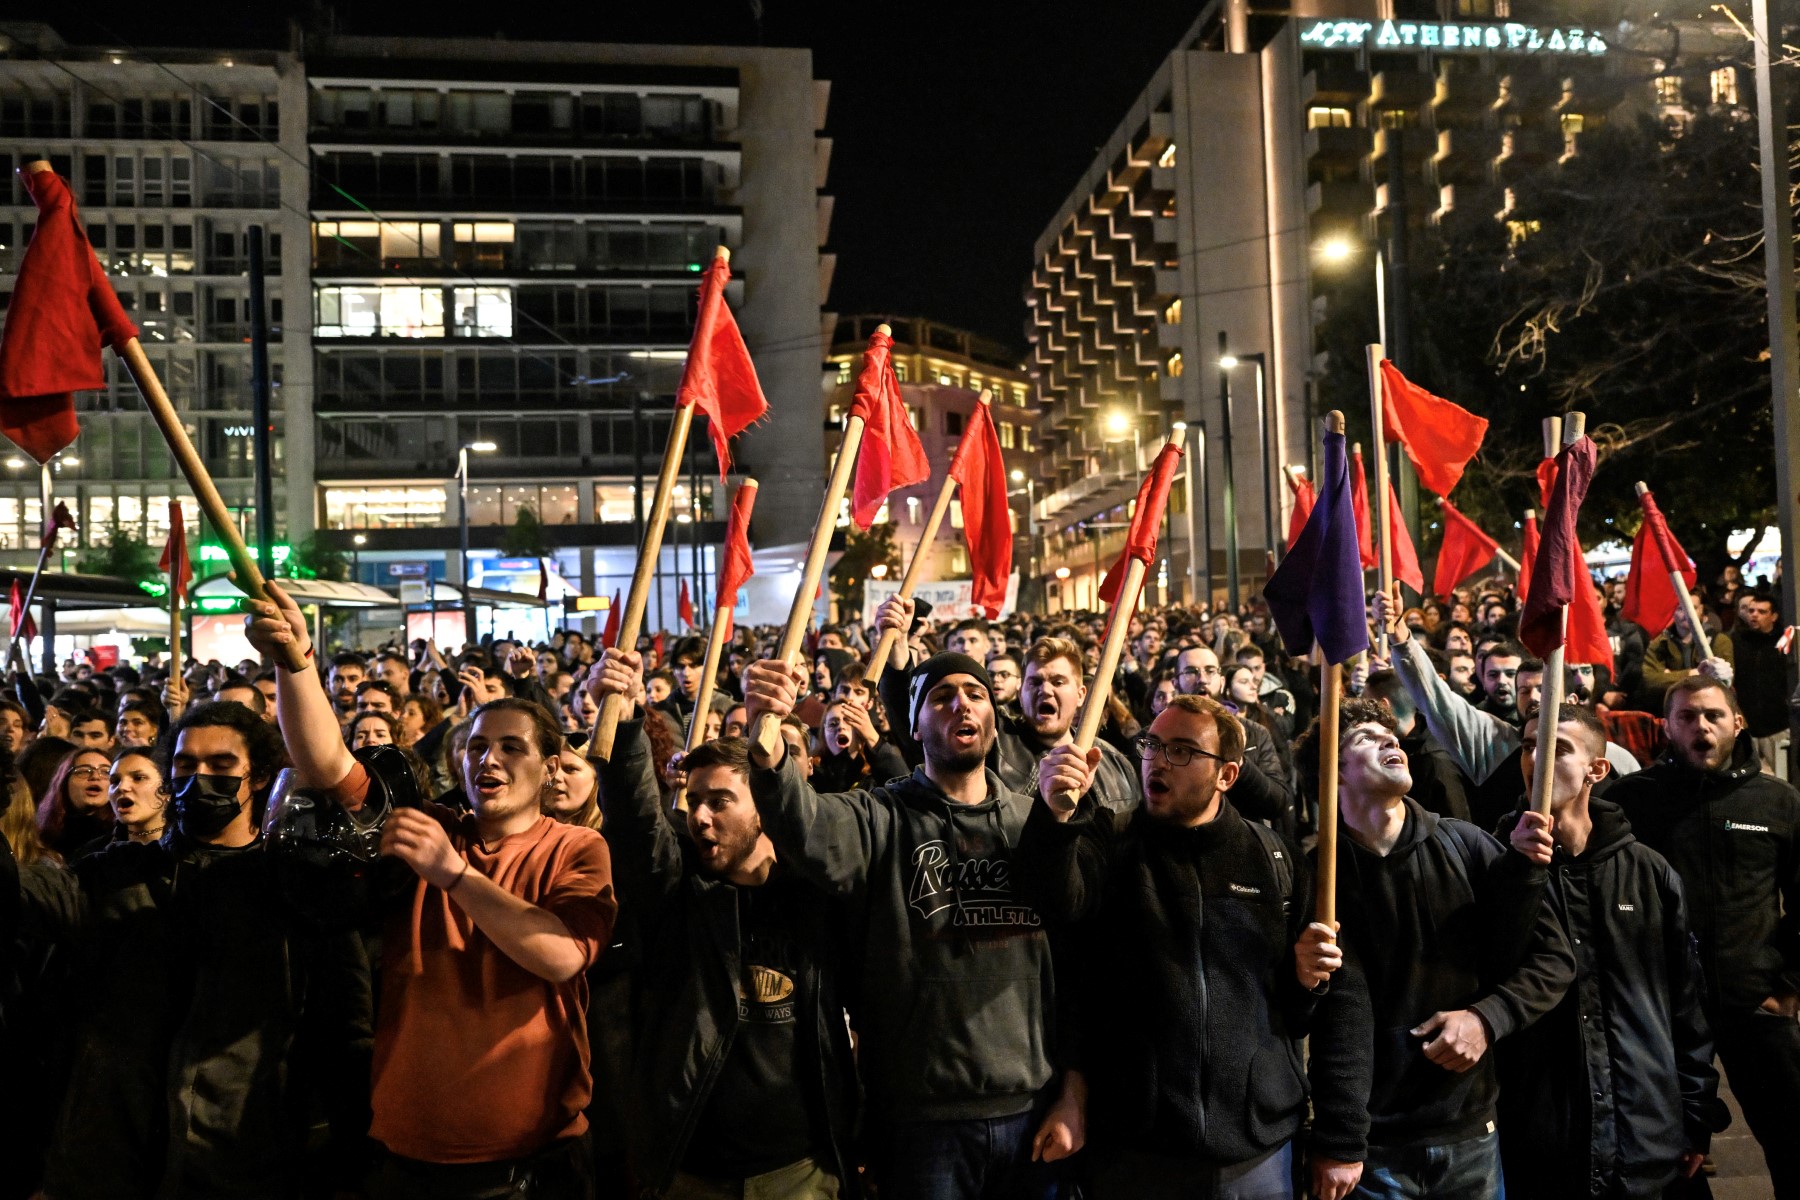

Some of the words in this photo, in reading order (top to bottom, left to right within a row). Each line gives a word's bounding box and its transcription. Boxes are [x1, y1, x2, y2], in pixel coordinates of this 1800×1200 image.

[1505, 23, 1608, 53] PLAZA
[1731, 822, 1769, 832] EMERSON
[1618, 903, 1634, 912] VANS
[953, 906, 1041, 926] ATHLETIC
